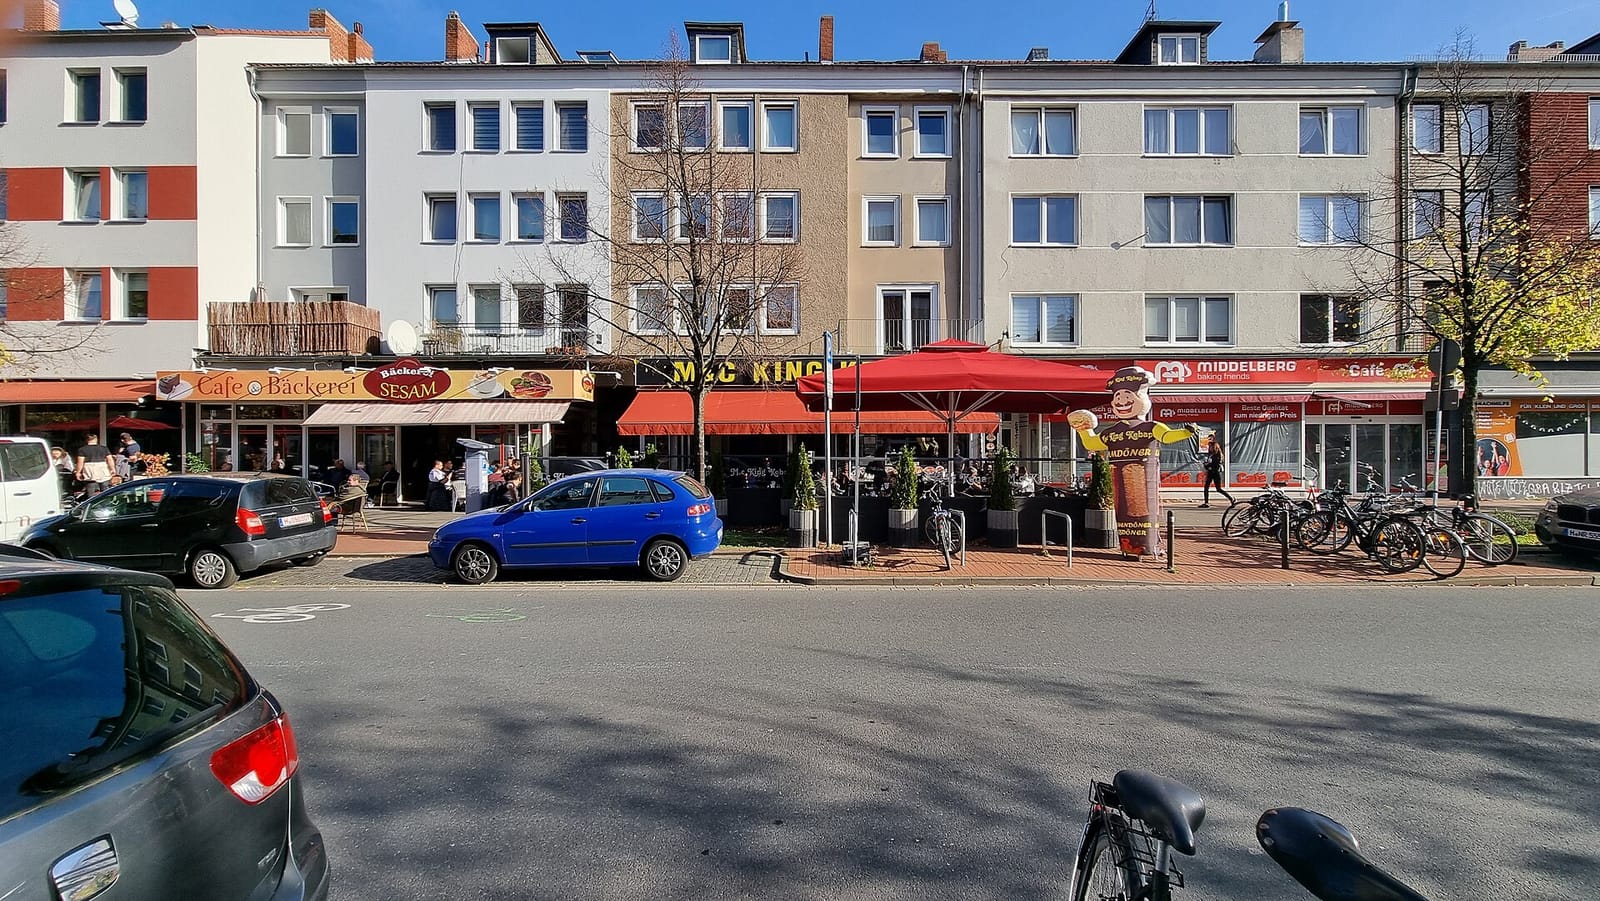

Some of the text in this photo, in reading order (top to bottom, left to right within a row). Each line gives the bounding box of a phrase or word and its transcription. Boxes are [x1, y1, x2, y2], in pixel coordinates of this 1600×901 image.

[1197, 361, 1297, 373] MIDDELBERG
[1197, 373, 1250, 382] baking friends
[197, 376, 243, 399] Cafe
[267, 376, 356, 398] Bäckerei
[380, 381, 438, 400] SESAM
